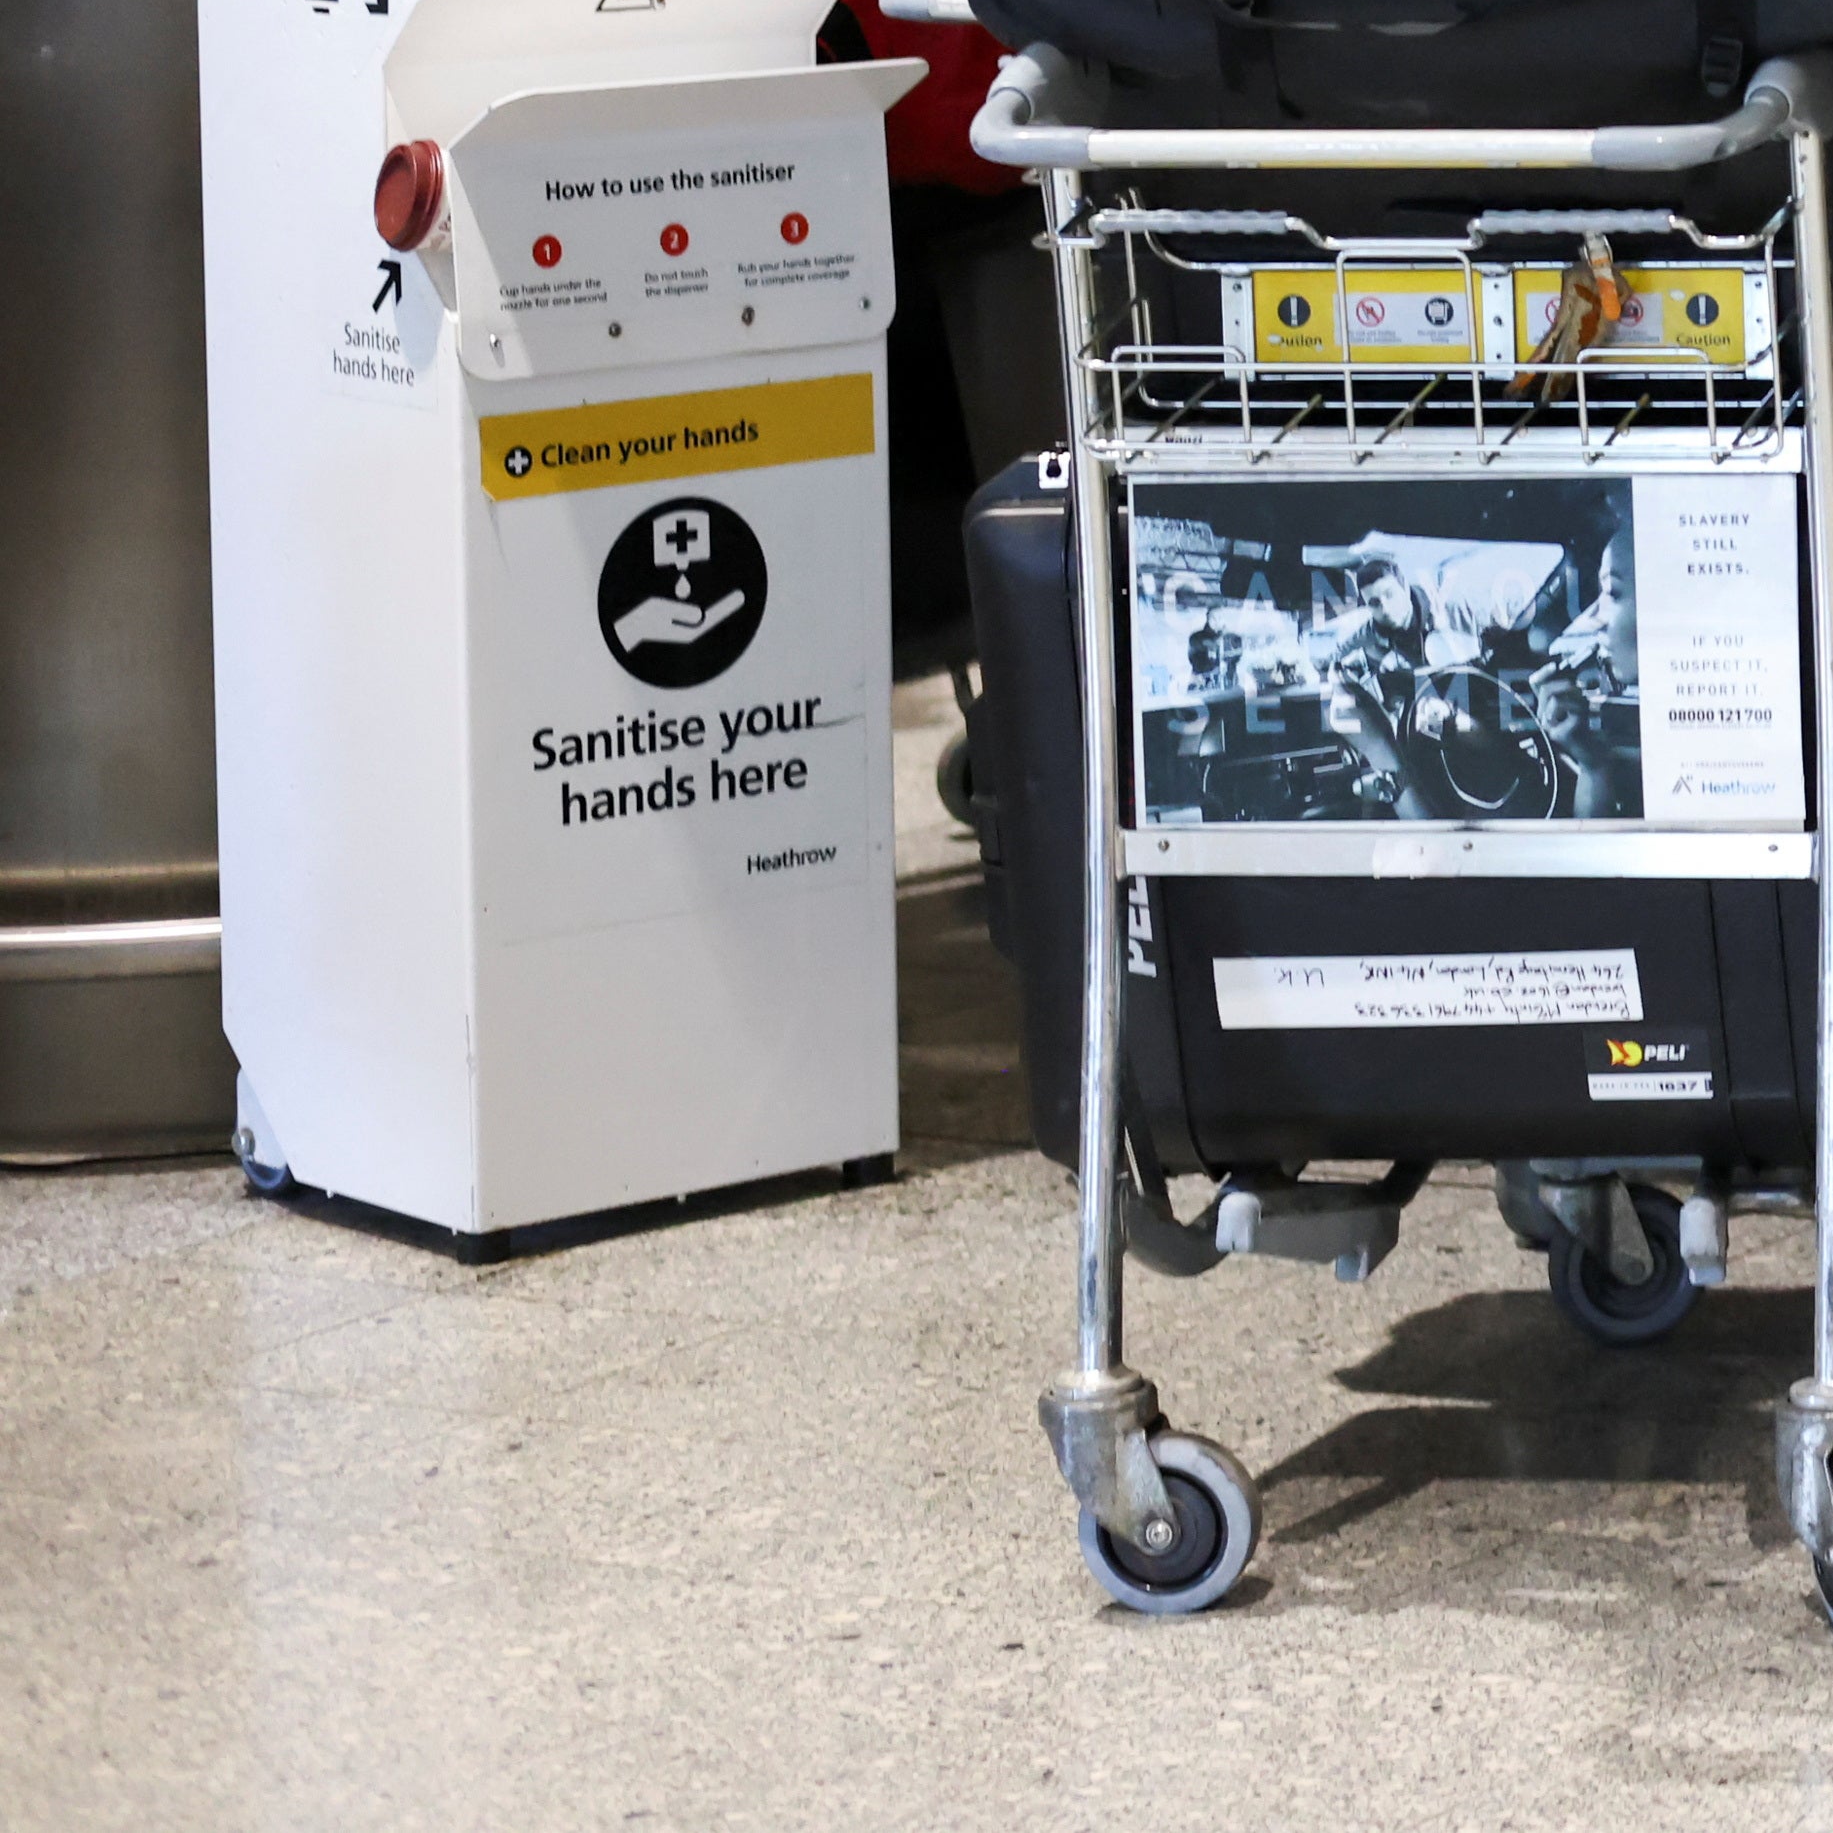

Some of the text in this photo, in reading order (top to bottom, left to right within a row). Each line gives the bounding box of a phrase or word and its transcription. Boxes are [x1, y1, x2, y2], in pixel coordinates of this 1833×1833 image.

[545, 162, 796, 202] How to use the sanitiser
[669, 230, 680, 250] 2
[543, 242, 552, 262] 1
[781, 257, 812, 271] hands
[500, 277, 602, 298] Cup hands under the
[744, 276, 759, 288] for
[534, 296, 550, 309] for
[573, 292, 608, 306] second
[343, 321, 401, 355] Sanitise
[1280, 334, 1322, 347] ution
[1676, 333, 1732, 347] Caution
[332, 352, 415, 388] hands here
[540, 417, 760, 470] Clean your hands
[1678, 513, 1750, 528] SLAVERY
[1693, 539, 1738, 551] STILL
[1687, 563, 1750, 576] EXISTS.
[1693, 635, 1744, 647] IF YOU
[1670, 660, 1740, 673] SUSPECT
[1676, 685, 1738, 697] REPORT
[1166, 667, 1362, 734] SEE
[1668, 708, 1773, 723] 08000 121 700
[532, 694, 822, 772] Sanitise your
[560, 750, 808, 826] hands here
[1701, 779, 1777, 796] Heathrow
[747, 843, 837, 876] Heathrow
[1127, 875, 1157, 978] PEL
[1644, 1043, 1686, 1062] PELI
